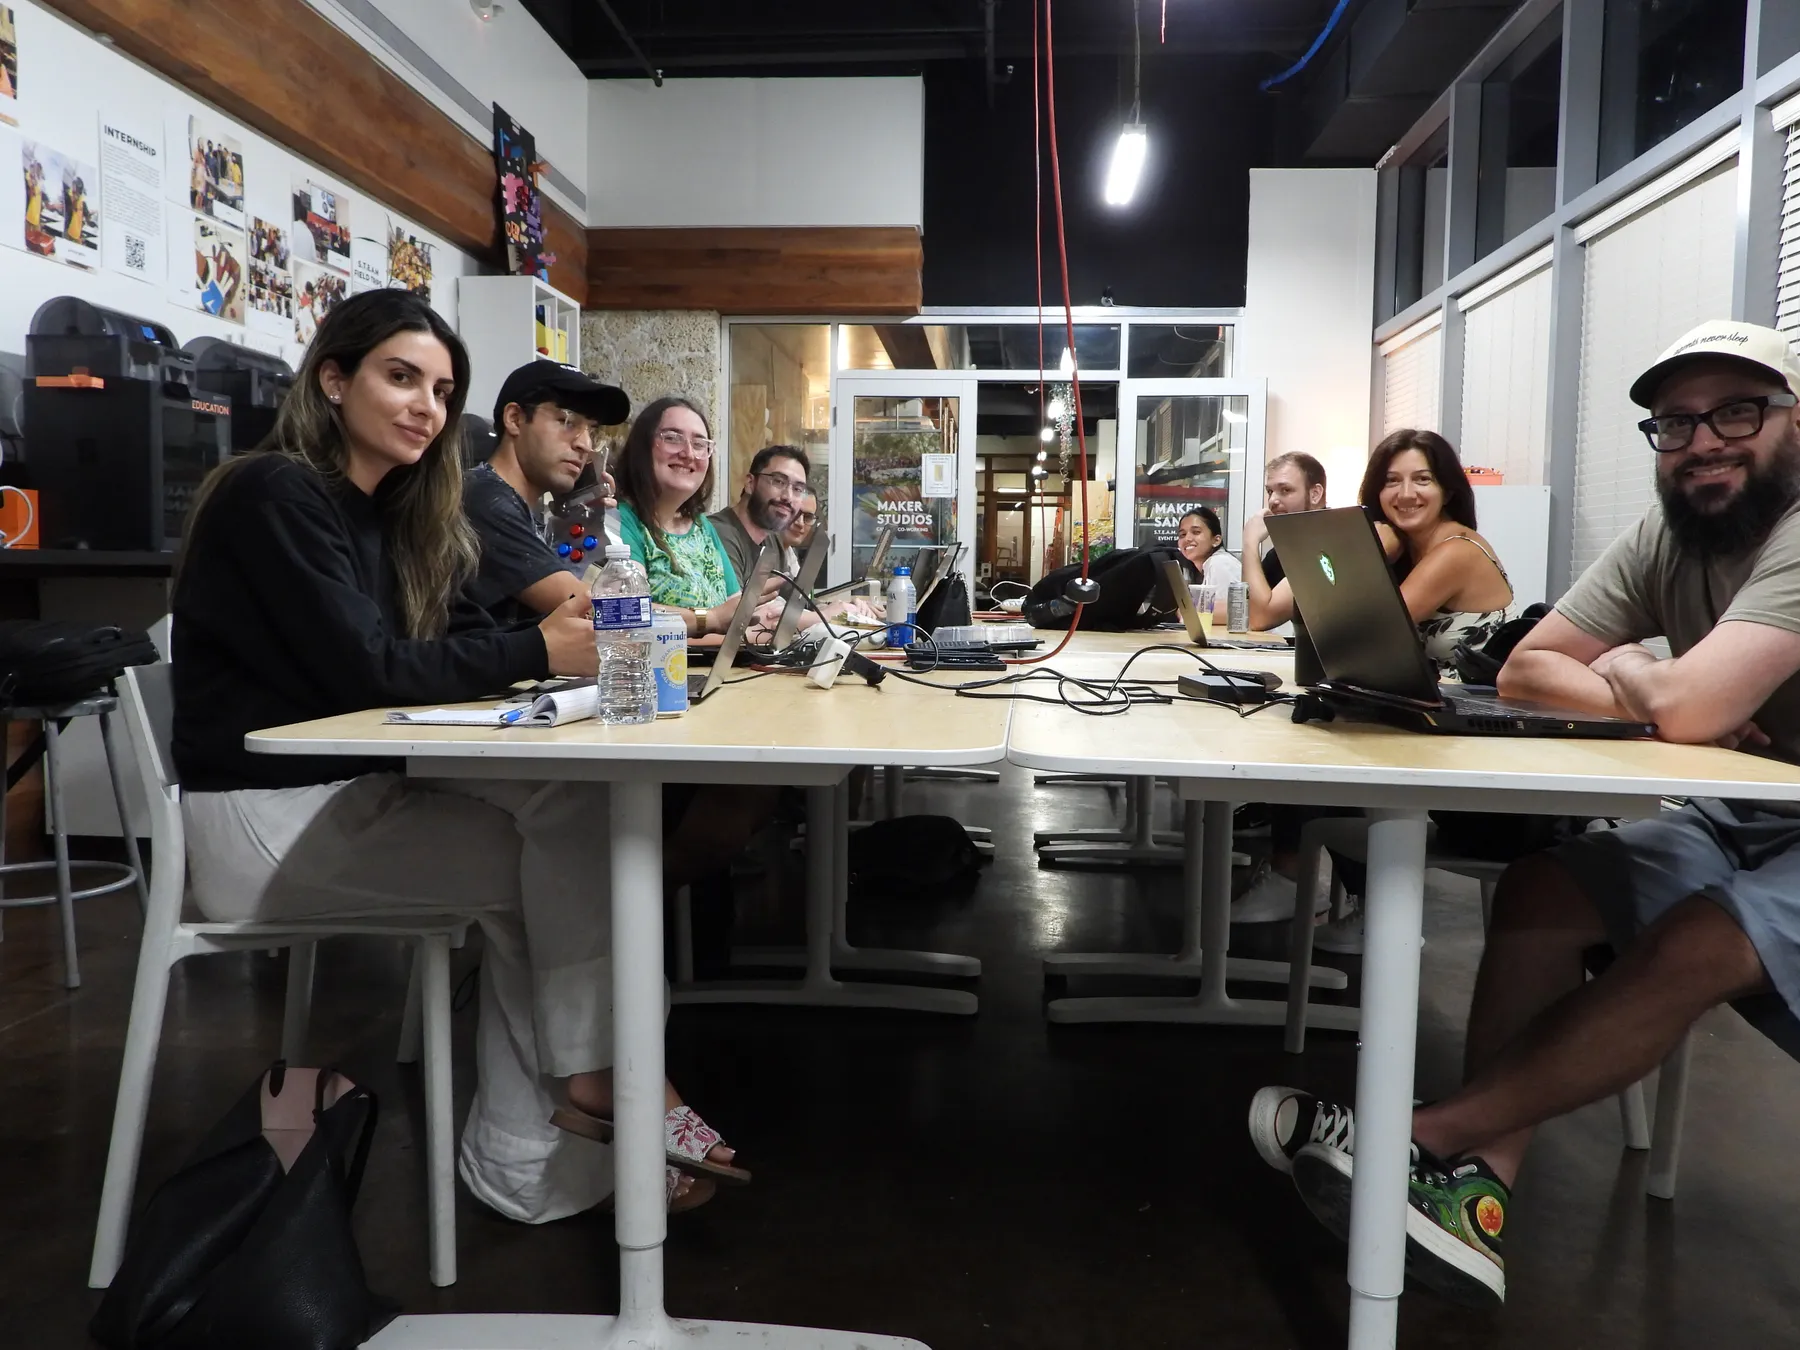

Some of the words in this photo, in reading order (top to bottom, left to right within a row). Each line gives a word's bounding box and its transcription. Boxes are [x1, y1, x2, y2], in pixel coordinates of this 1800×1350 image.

[104, 124, 156, 156] INTERNSHIP
[354, 269, 370, 281] FIELD
[1700, 334, 1727, 344] never
[1727, 331, 1748, 346] sleep
[191, 399, 230, 416] EDUCATION
[877, 500, 924, 512] MAKER
[877, 514, 933, 525] STUDIOS
[656, 631, 686, 644] spindr
